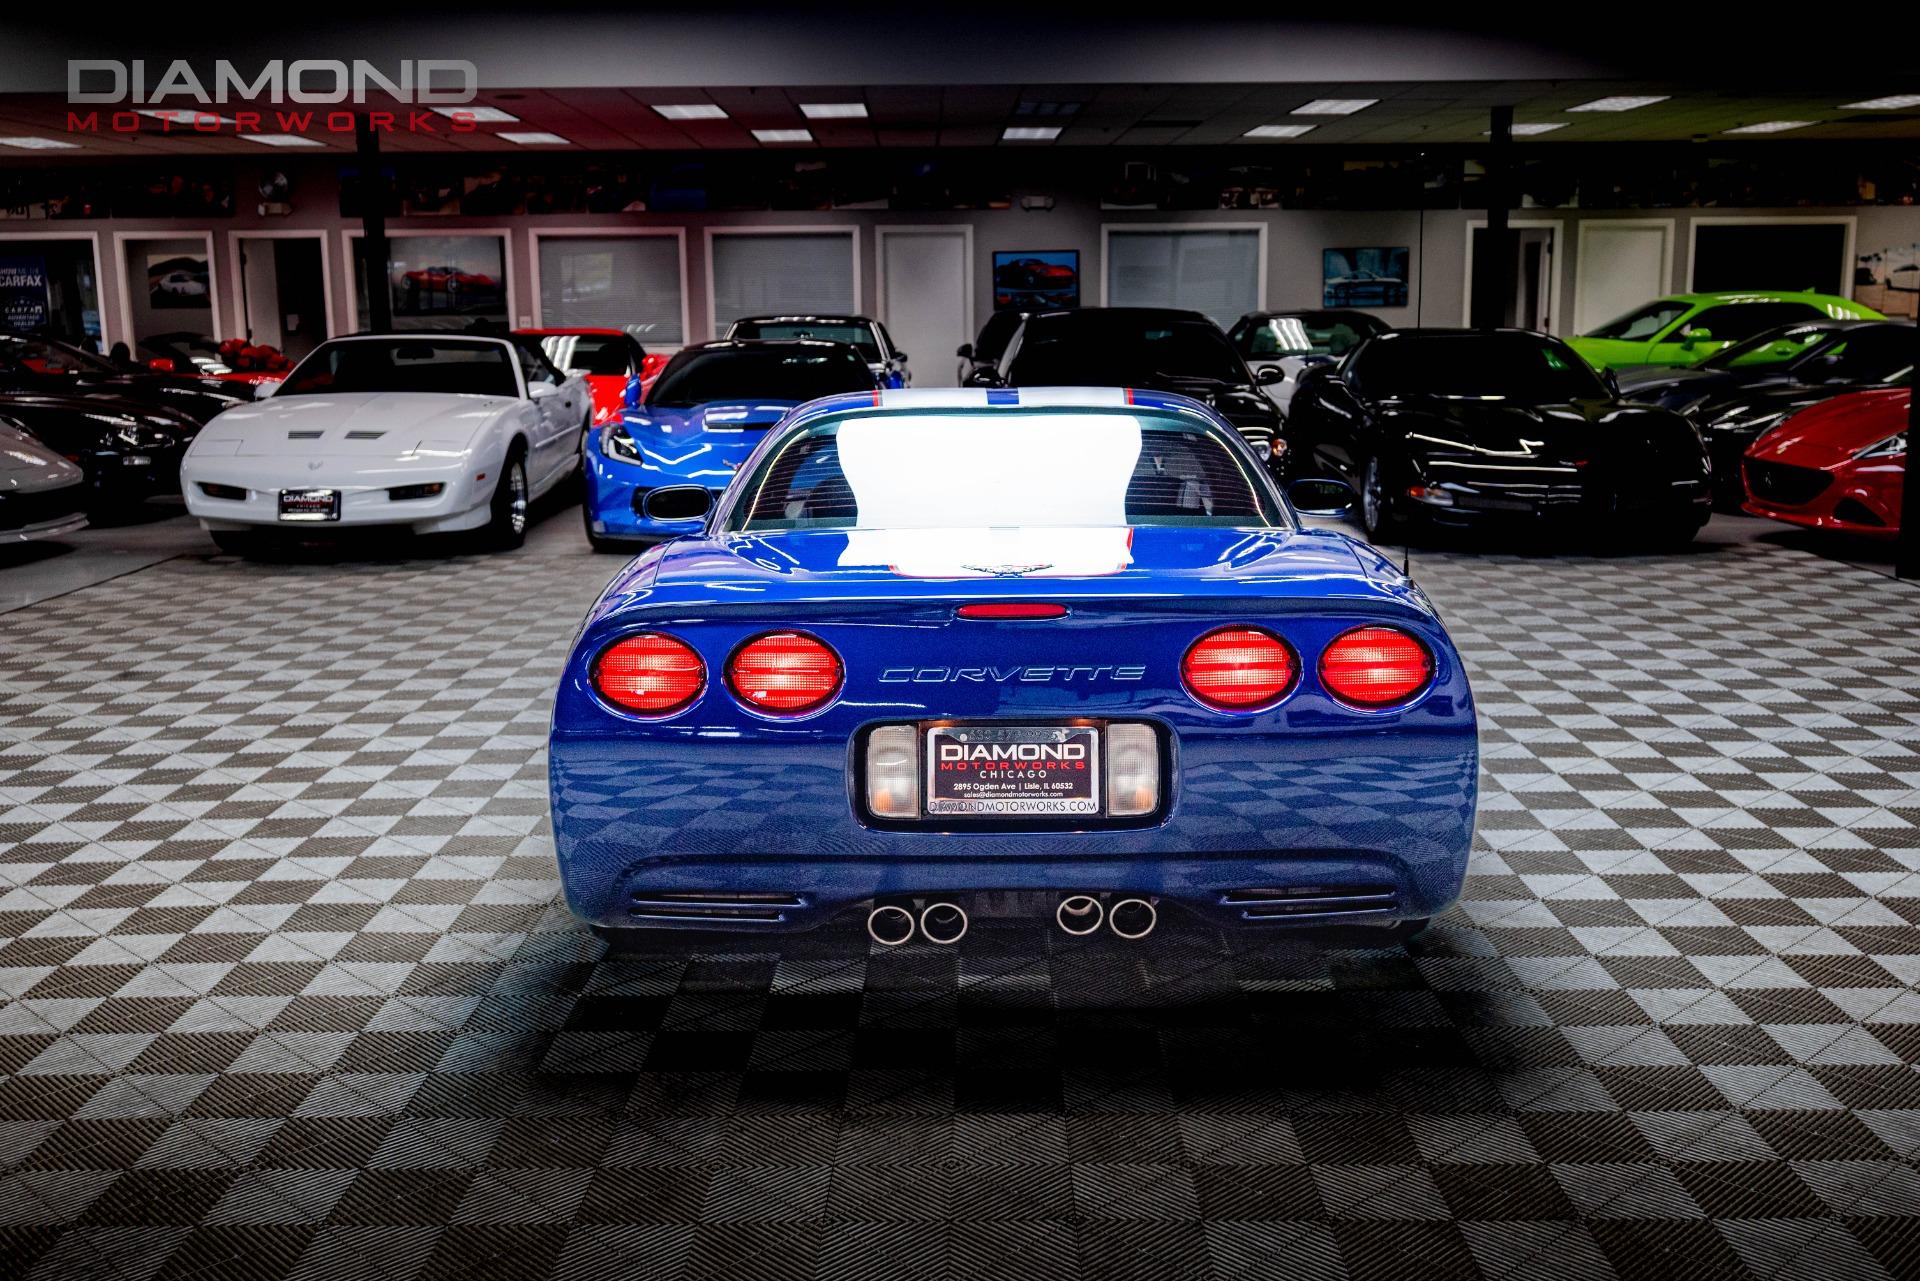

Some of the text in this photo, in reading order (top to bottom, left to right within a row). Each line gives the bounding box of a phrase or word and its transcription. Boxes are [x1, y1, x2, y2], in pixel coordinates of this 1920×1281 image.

[0, 275, 43, 288] CARFAX
[283, 495, 334, 503] DIAMOND
[878, 665, 1147, 683] CORVETTE
[941, 744, 1085, 761] DIAMOND
[941, 761, 1086, 770] MOTORWORKS
[979, 770, 1047, 779] CHICAGO
[973, 783, 999, 792] Ogden
[1051, 782, 1073, 790] 60532
[963, 790, 1064, 799] sales@diamondmotorworks.com
